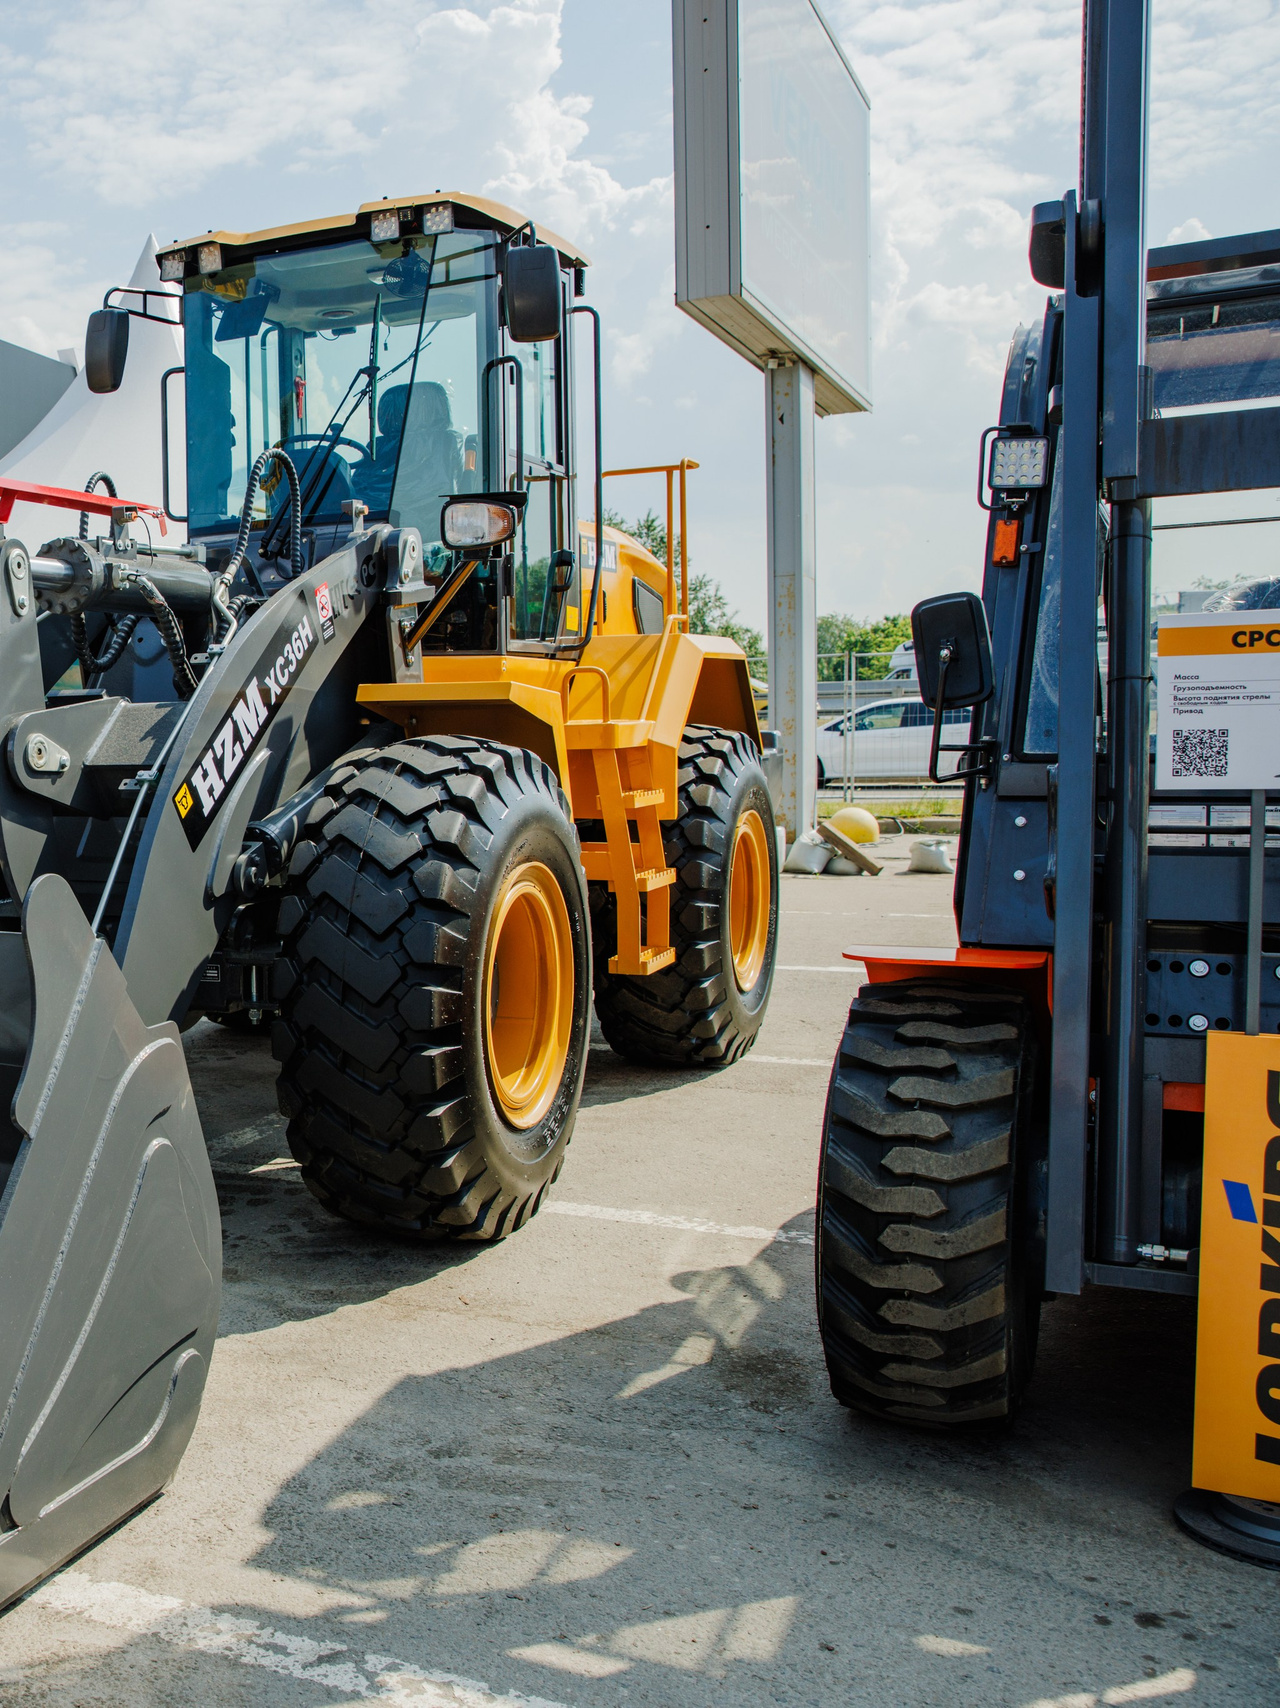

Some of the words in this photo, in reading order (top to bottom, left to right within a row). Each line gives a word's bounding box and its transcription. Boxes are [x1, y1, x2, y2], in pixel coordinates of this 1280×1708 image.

[588, 541, 616, 569] HM
[1173, 684, 1247, 693] Грузоподъемность
[191, 676, 268, 817] HZM
[264, 615, 313, 705] XC36H
[1173, 707, 1203, 715] Привод
